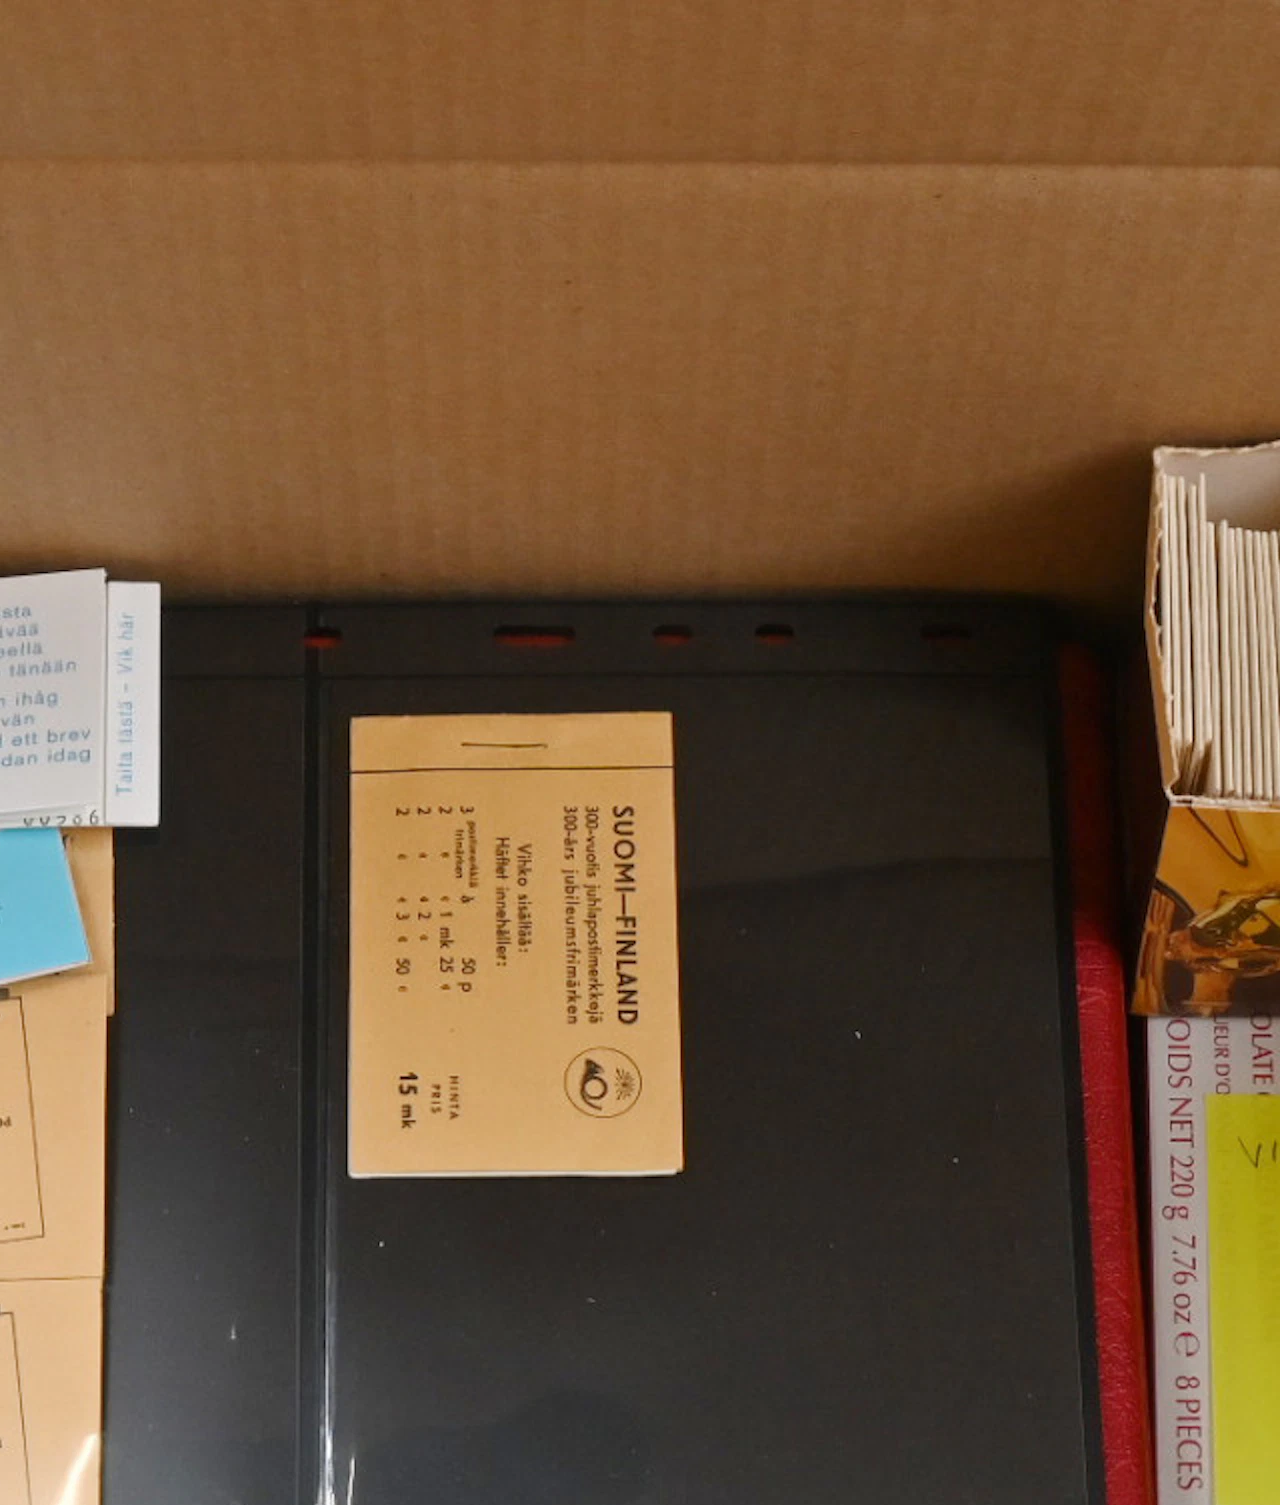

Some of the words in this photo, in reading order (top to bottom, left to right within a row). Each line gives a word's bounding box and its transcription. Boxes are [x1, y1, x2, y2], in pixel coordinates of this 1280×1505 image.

[9, 660, 77, 679] tänään
[15, 690, 59, 707] ihåg
[1, 713, 35, 728] vän
[11, 732, 38, 746] ett
[47, 727, 92, 743] brev
[48, 747, 92, 764] idag
[396, 807, 410, 817] 2
[417, 806, 431, 815] 2
[438, 806, 452, 815] 2
[459, 806, 475, 814] 3
[495, 837, 511, 879] Häftet
[517, 843, 532, 887] Vihko
[396, 912, 410, 921] 3
[418, 911, 432, 920] 2
[440, 927, 454, 949] mk
[396, 958, 411, 975] 50
[440, 956, 454, 973] 25
[461, 957, 475, 975] 50
[457, 981, 472, 992] p
[398, 1071, 418, 1096] 15
[431, 1084, 441, 1114] PRIS
[449, 1075, 459, 1120] HINTA
[401, 1104, 416, 1129] mk
[1170, 1098, 1195, 1149] NET
[1170, 1156, 1195, 1197] 220
[1162, 1205, 1189, 1221] g
[1171, 1235, 1198, 1286] 7.76
[1174, 1294, 1191, 1324] oz
[1175, 1375, 1200, 1390] 8
[1175, 1399, 1203, 1491] PIECES
